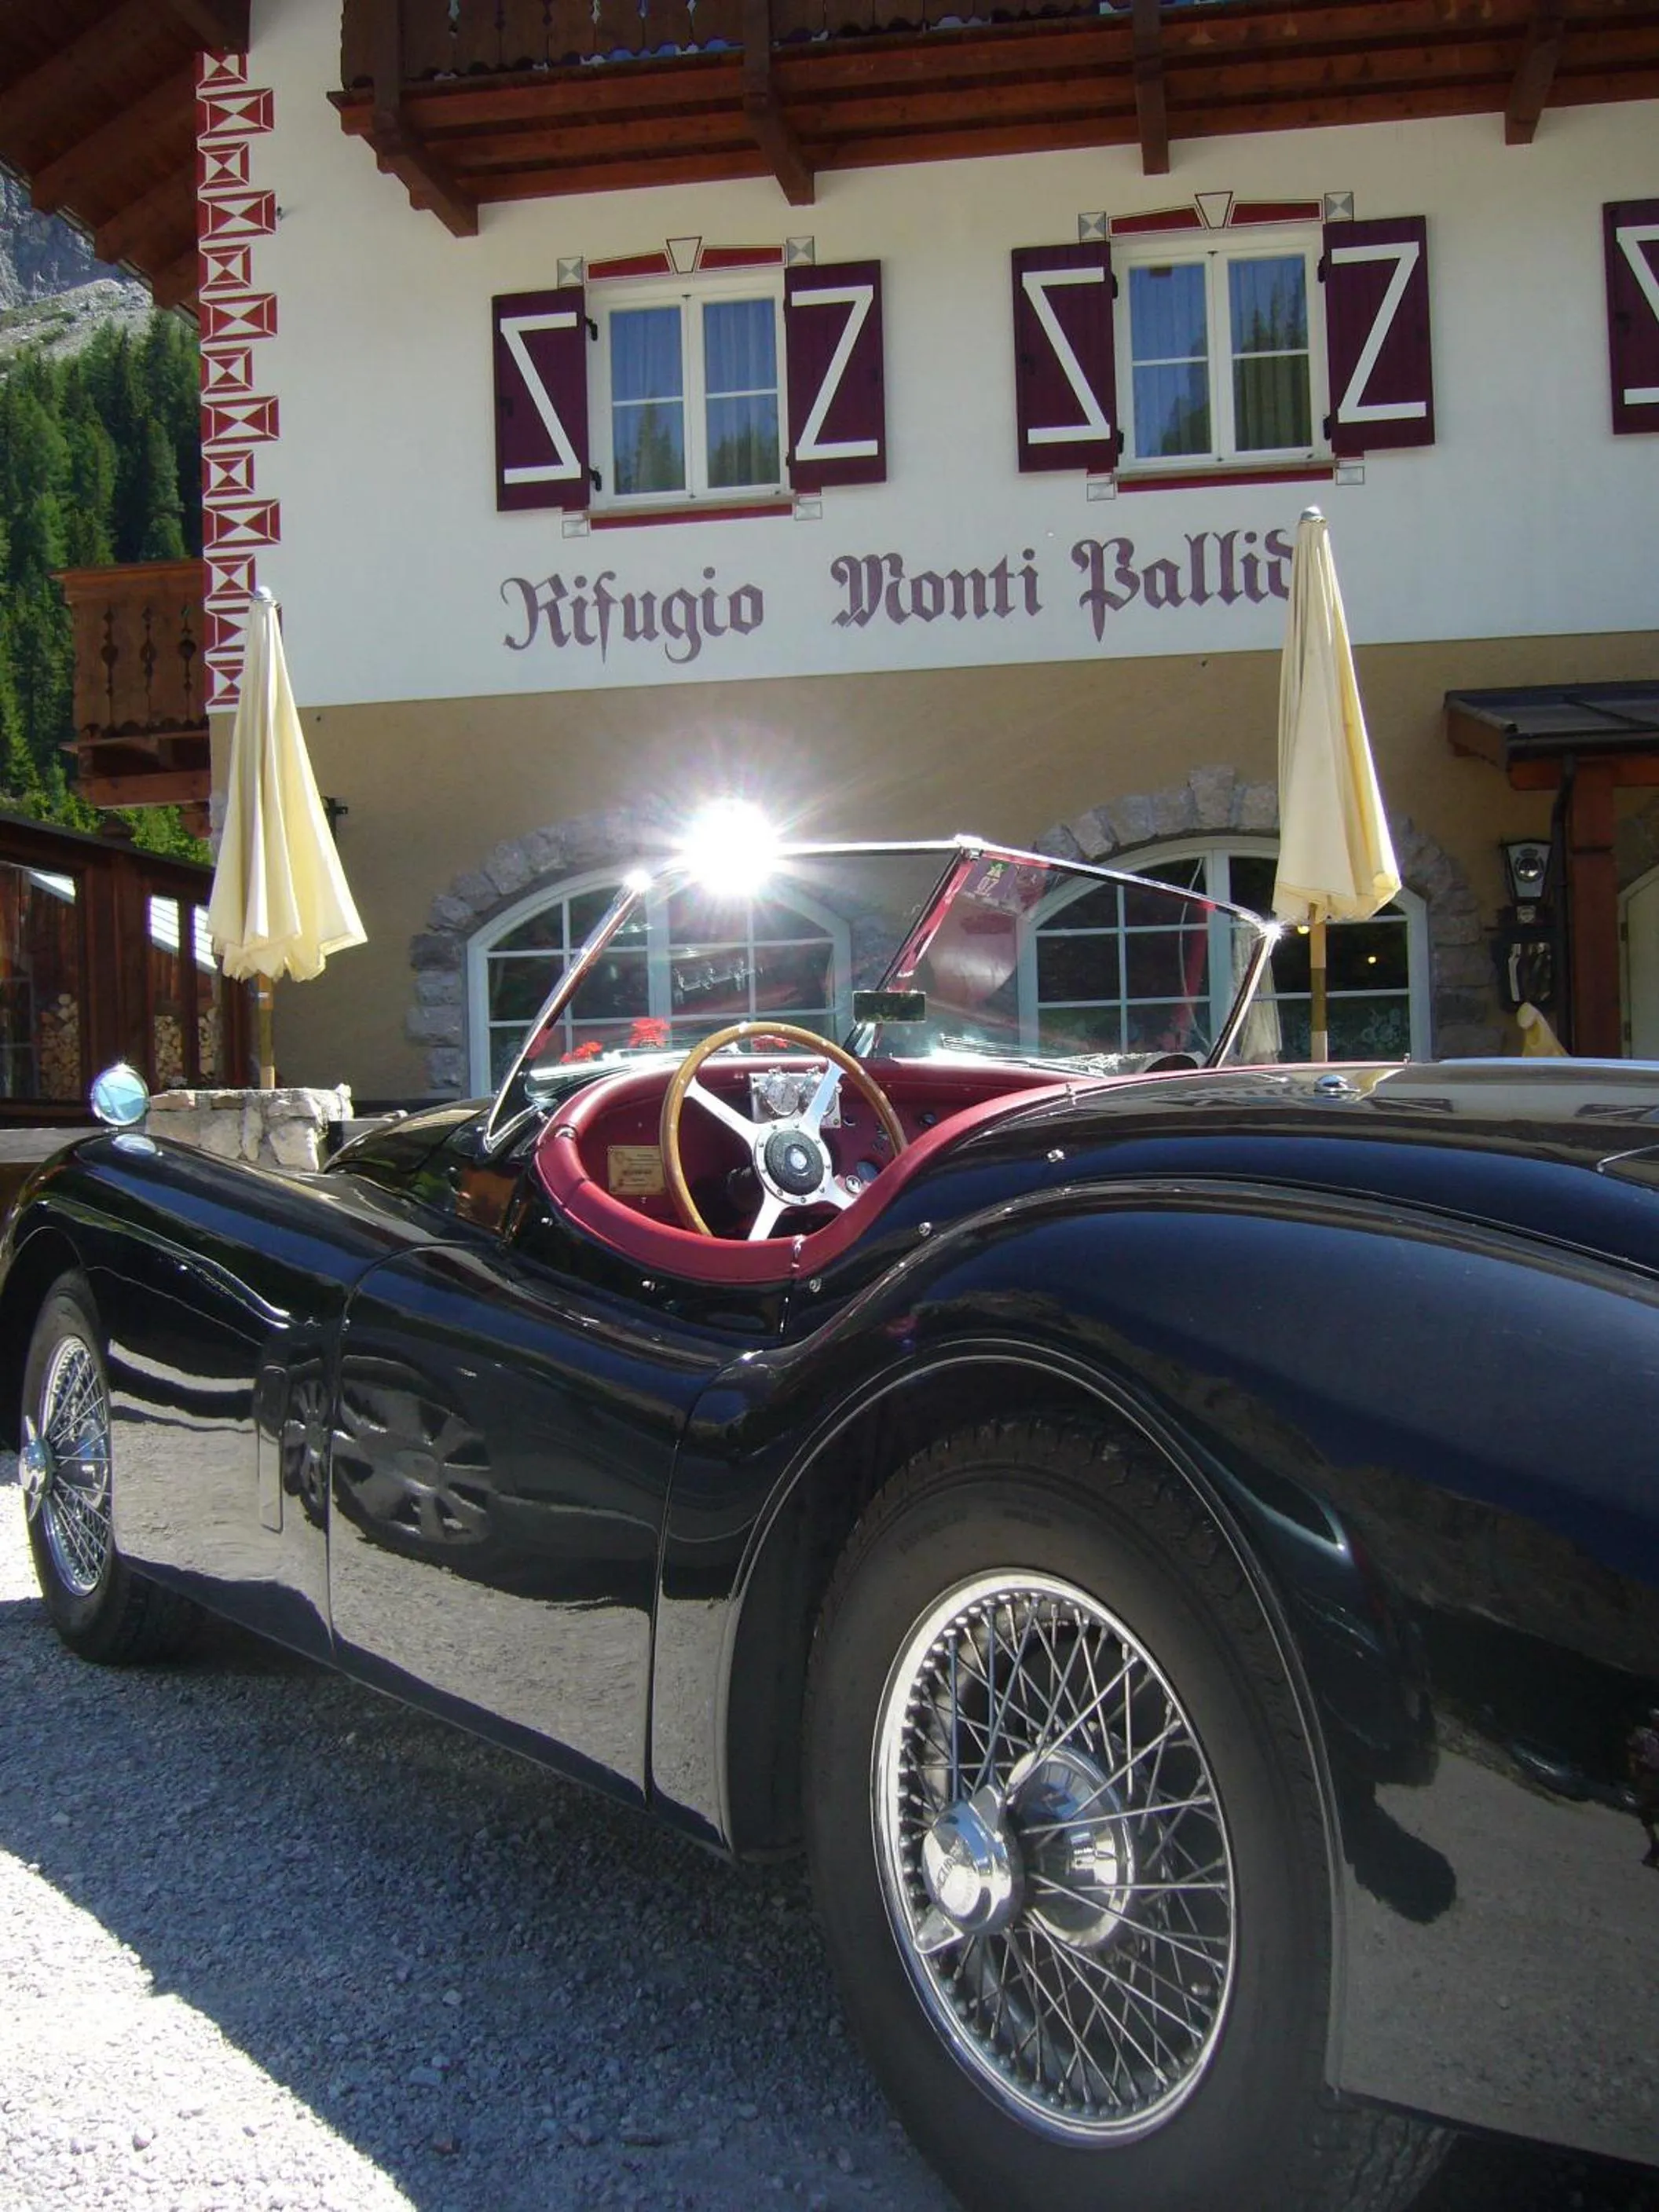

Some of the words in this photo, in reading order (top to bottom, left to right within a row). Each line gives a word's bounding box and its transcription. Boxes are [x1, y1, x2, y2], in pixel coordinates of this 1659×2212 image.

[500, 566, 764, 665] Rifugio
[830, 548, 1043, 628] Monti
[1071, 529, 1295, 643] Pallid
